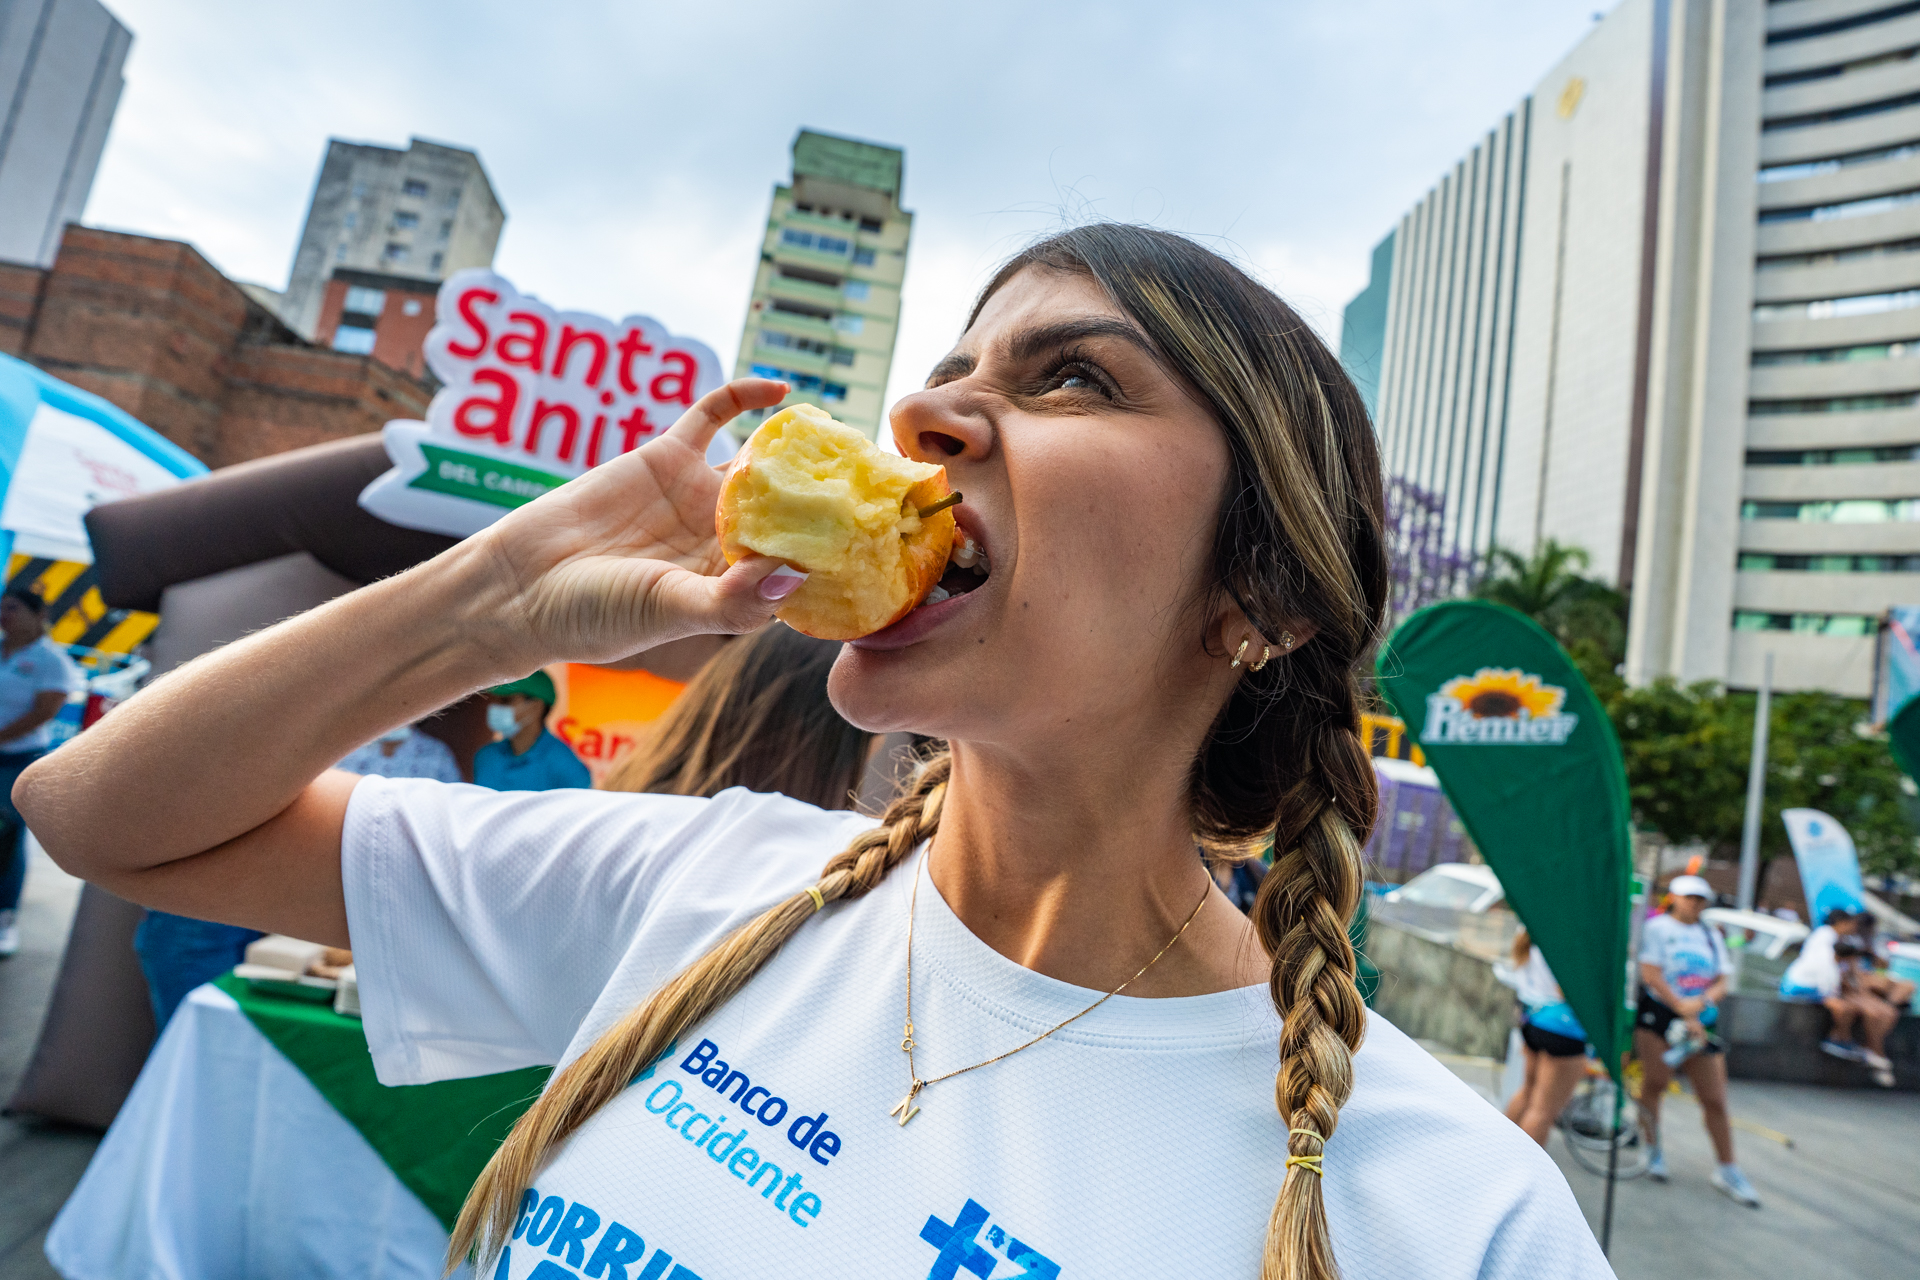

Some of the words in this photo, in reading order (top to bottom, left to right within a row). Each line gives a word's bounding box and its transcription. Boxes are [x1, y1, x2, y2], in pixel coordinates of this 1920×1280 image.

[447, 288, 698, 408] Santa
[453, 367, 668, 470] anit
[645, 1079, 822, 1228] Occidente
[679, 1038, 788, 1127] Banco
[787, 1112, 842, 1166] de
